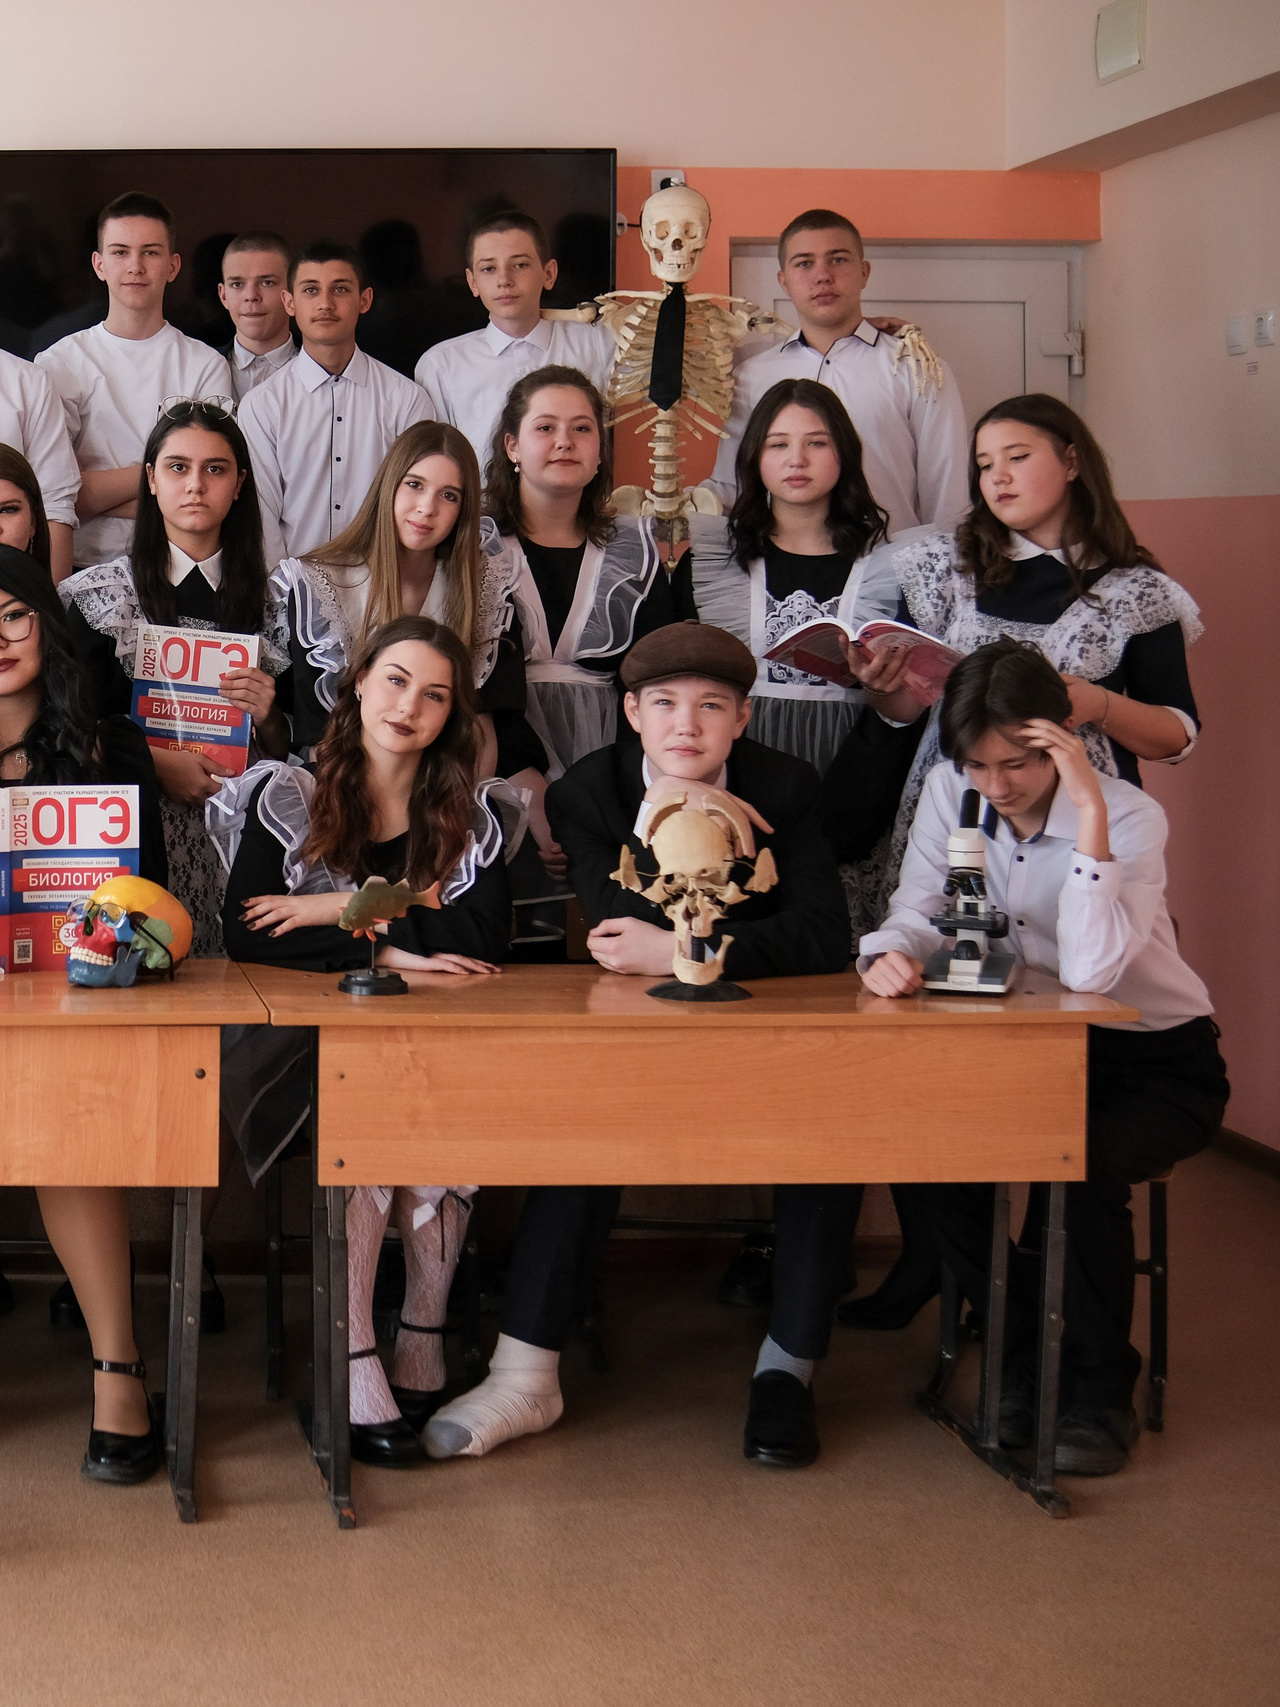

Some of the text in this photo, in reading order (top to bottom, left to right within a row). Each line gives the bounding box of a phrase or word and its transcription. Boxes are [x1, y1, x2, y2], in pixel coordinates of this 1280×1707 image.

[142, 648, 157, 677] 2025
[160, 637, 249, 682] ОГЭ
[152, 702, 228, 721] БИОЛОГИЯ
[14, 814, 27, 846] 2025
[32, 796, 130, 845] ОГЭ
